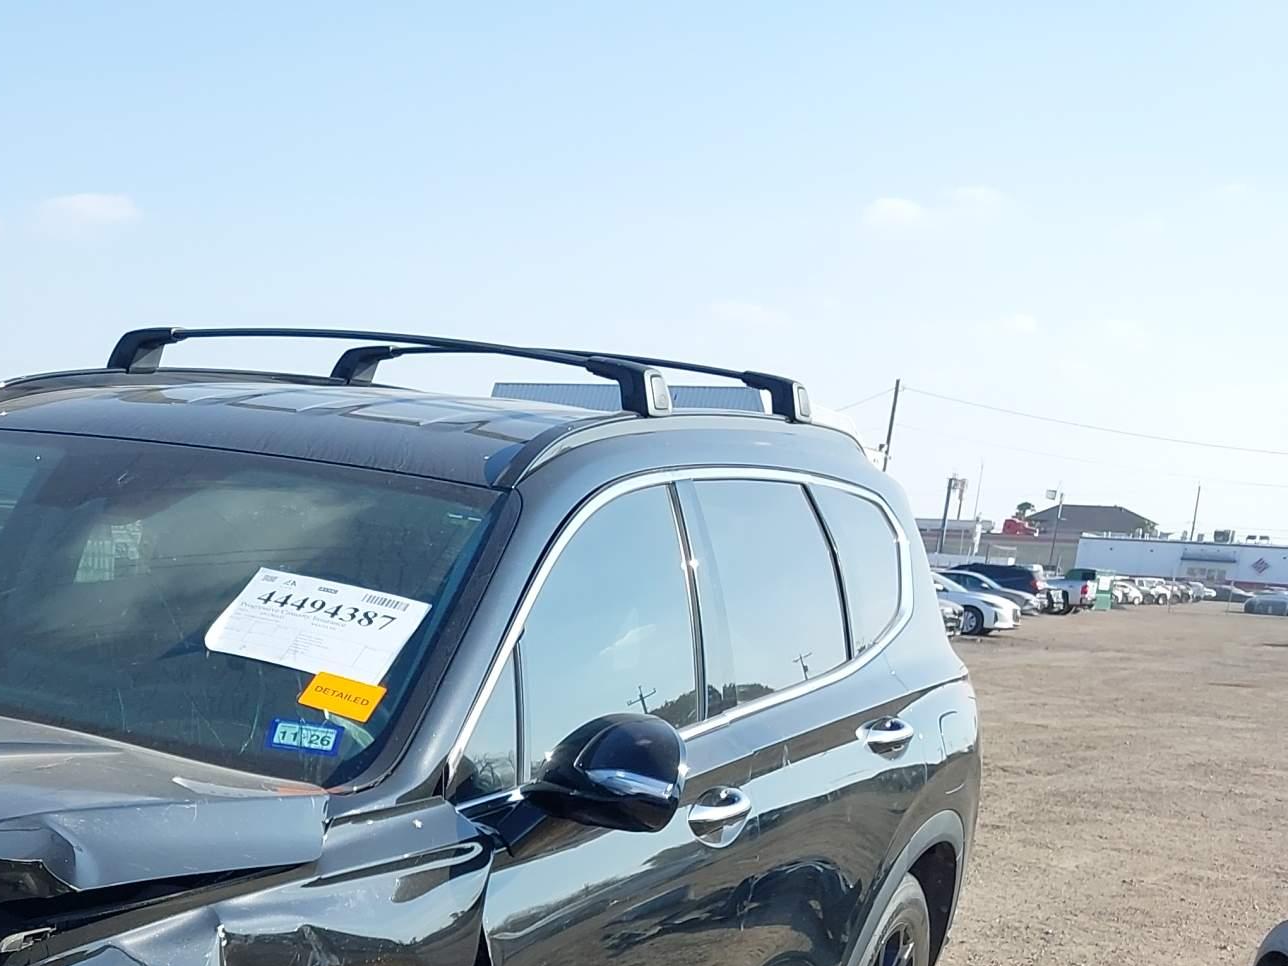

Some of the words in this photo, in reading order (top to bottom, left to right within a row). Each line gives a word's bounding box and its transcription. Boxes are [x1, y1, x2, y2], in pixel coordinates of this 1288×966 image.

[257, 590, 397, 631] 44494387
[314, 685, 370, 707] DETAILED
[279, 730, 299, 742] 11
[308, 733, 332, 747] 26
